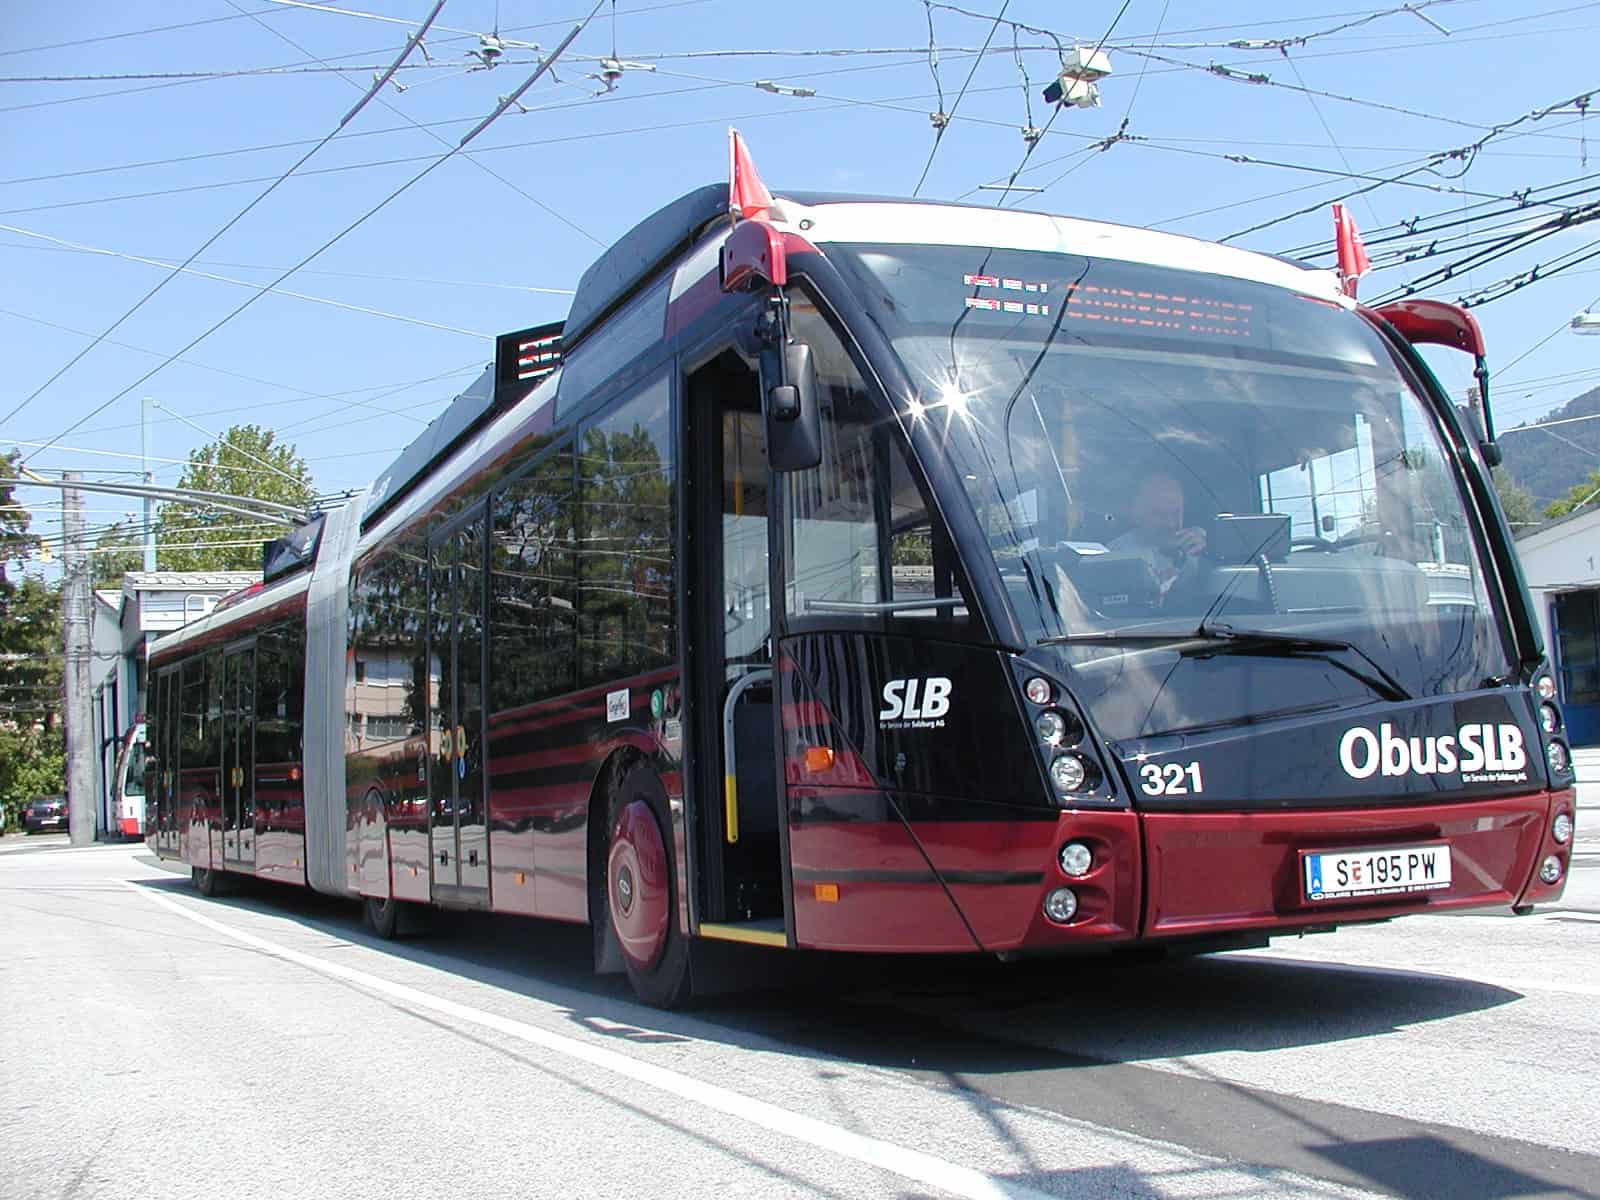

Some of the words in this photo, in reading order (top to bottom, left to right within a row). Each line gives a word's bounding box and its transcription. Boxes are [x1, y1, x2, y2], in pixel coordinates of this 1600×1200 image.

[880, 677, 952, 720] SLB
[1140, 761, 1202, 796] 321
[1313, 878, 1321, 889] A
[1337, 859, 1349, 887] S
[1366, 855, 1402, 884] 195
[1408, 852, 1435, 880] PW
